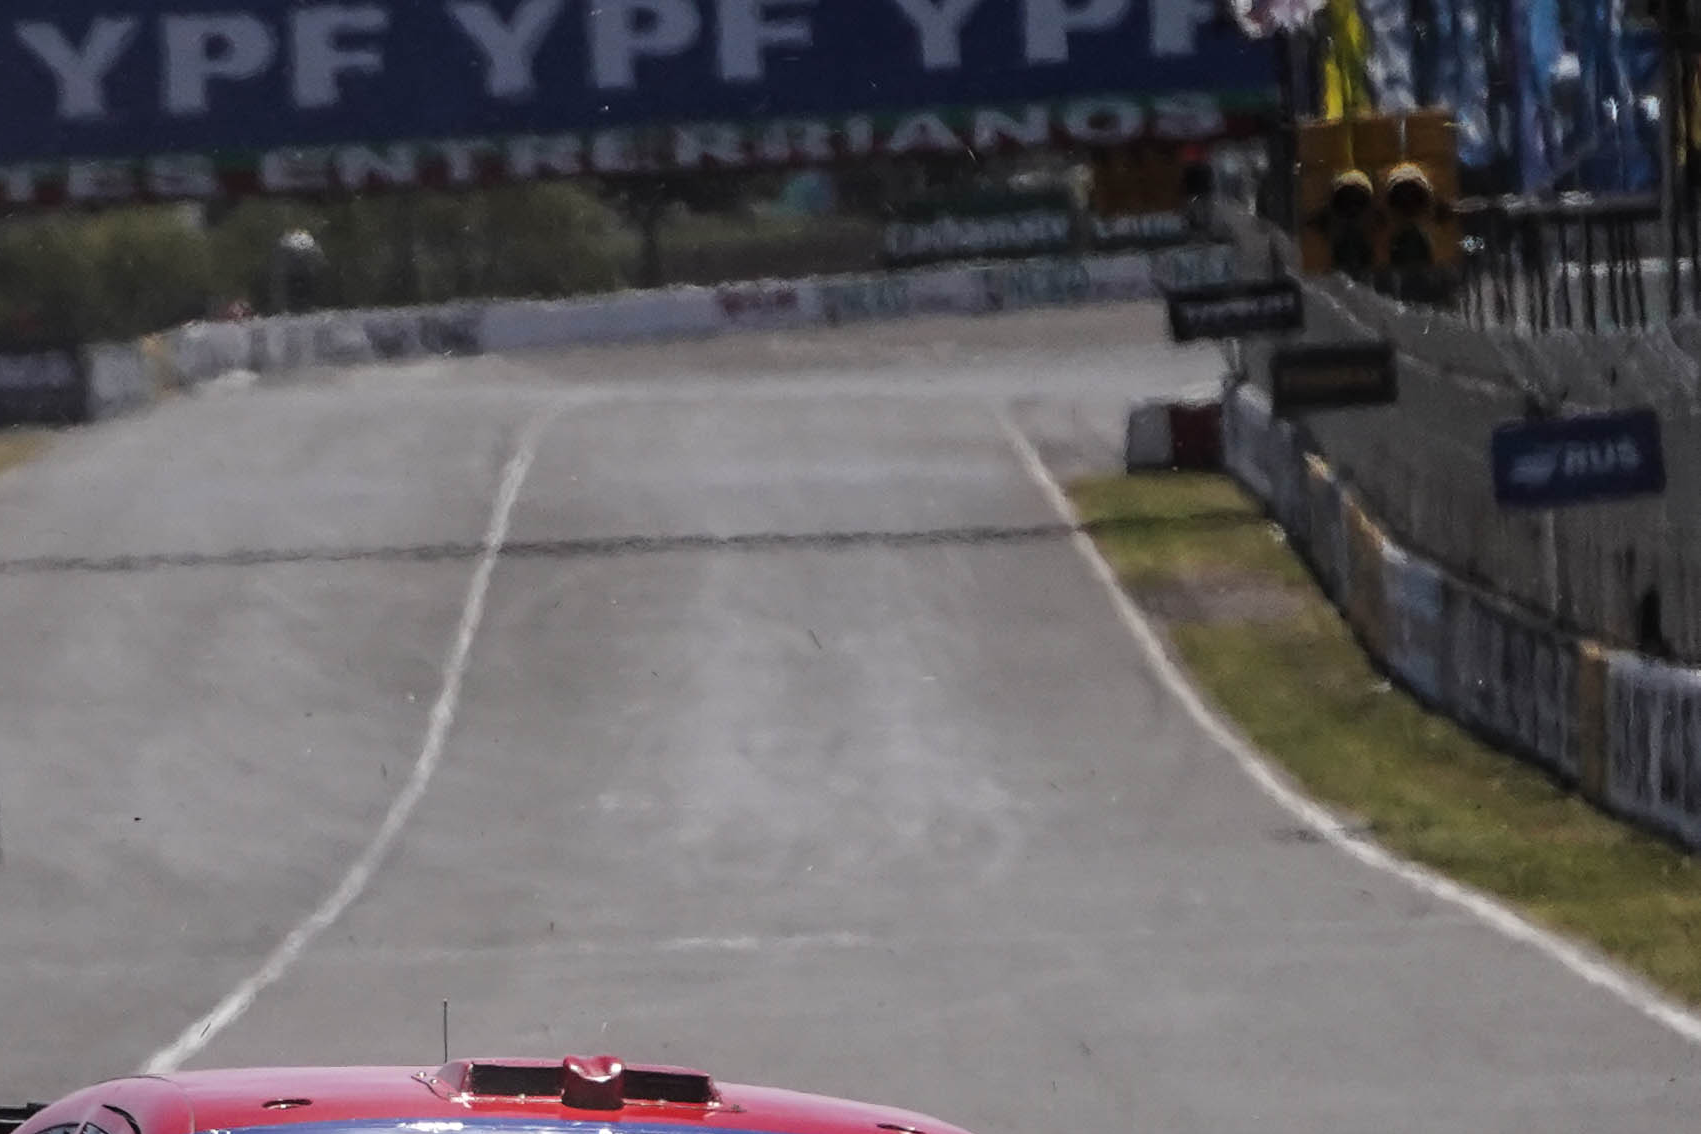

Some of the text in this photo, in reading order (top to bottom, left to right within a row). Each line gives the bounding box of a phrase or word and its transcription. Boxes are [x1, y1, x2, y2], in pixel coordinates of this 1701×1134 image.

[14, 8, 391, 120] YPF
[447, 0, 817, 99] YPF
[903, 0, 1217, 71] YPF
